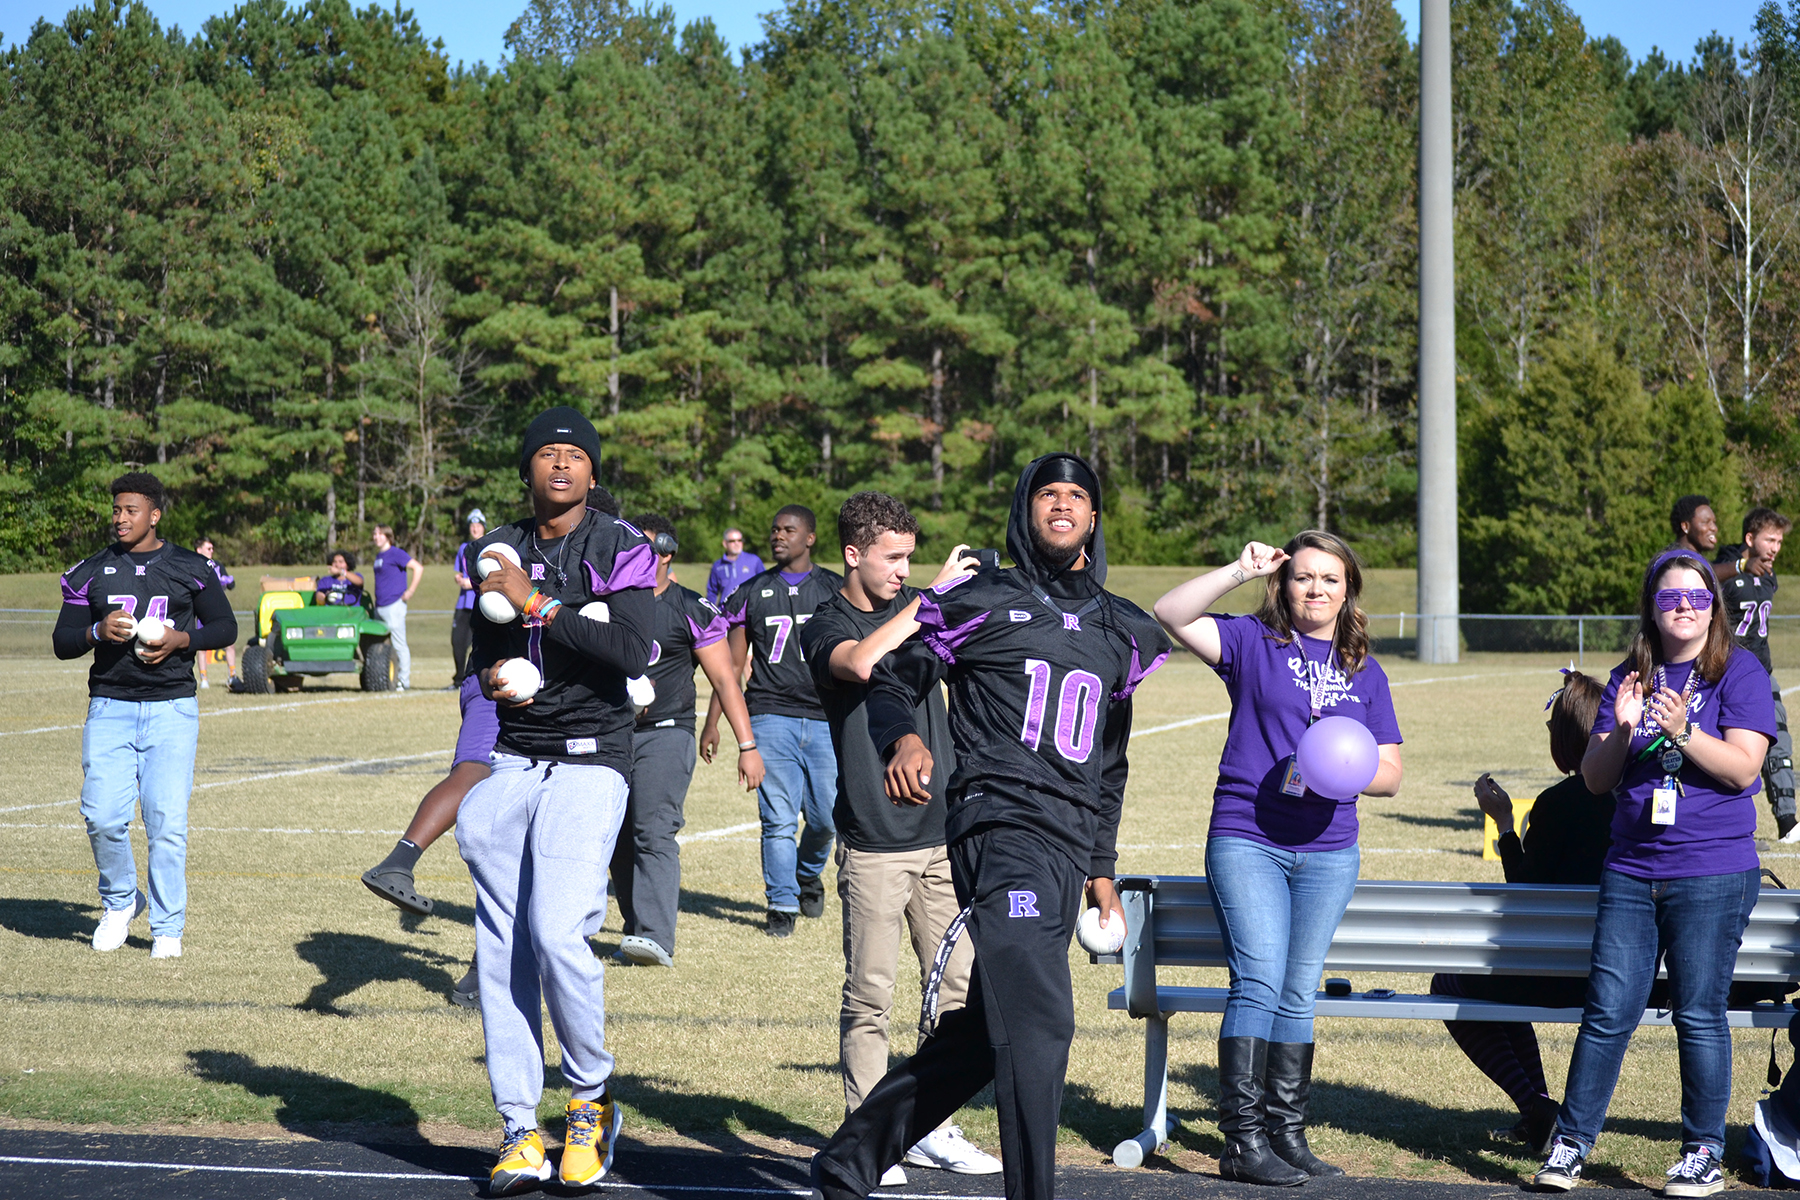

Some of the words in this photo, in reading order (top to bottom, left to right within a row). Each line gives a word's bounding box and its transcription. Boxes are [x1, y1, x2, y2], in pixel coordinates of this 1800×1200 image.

[135, 565, 146, 576] R
[531, 563, 546, 580] R
[788, 586, 799, 597] R
[1062, 612, 1082, 631] R
[1735, 600, 1773, 638] 70
[1020, 659, 1103, 764] 10
[1008, 891, 1040, 918] R
